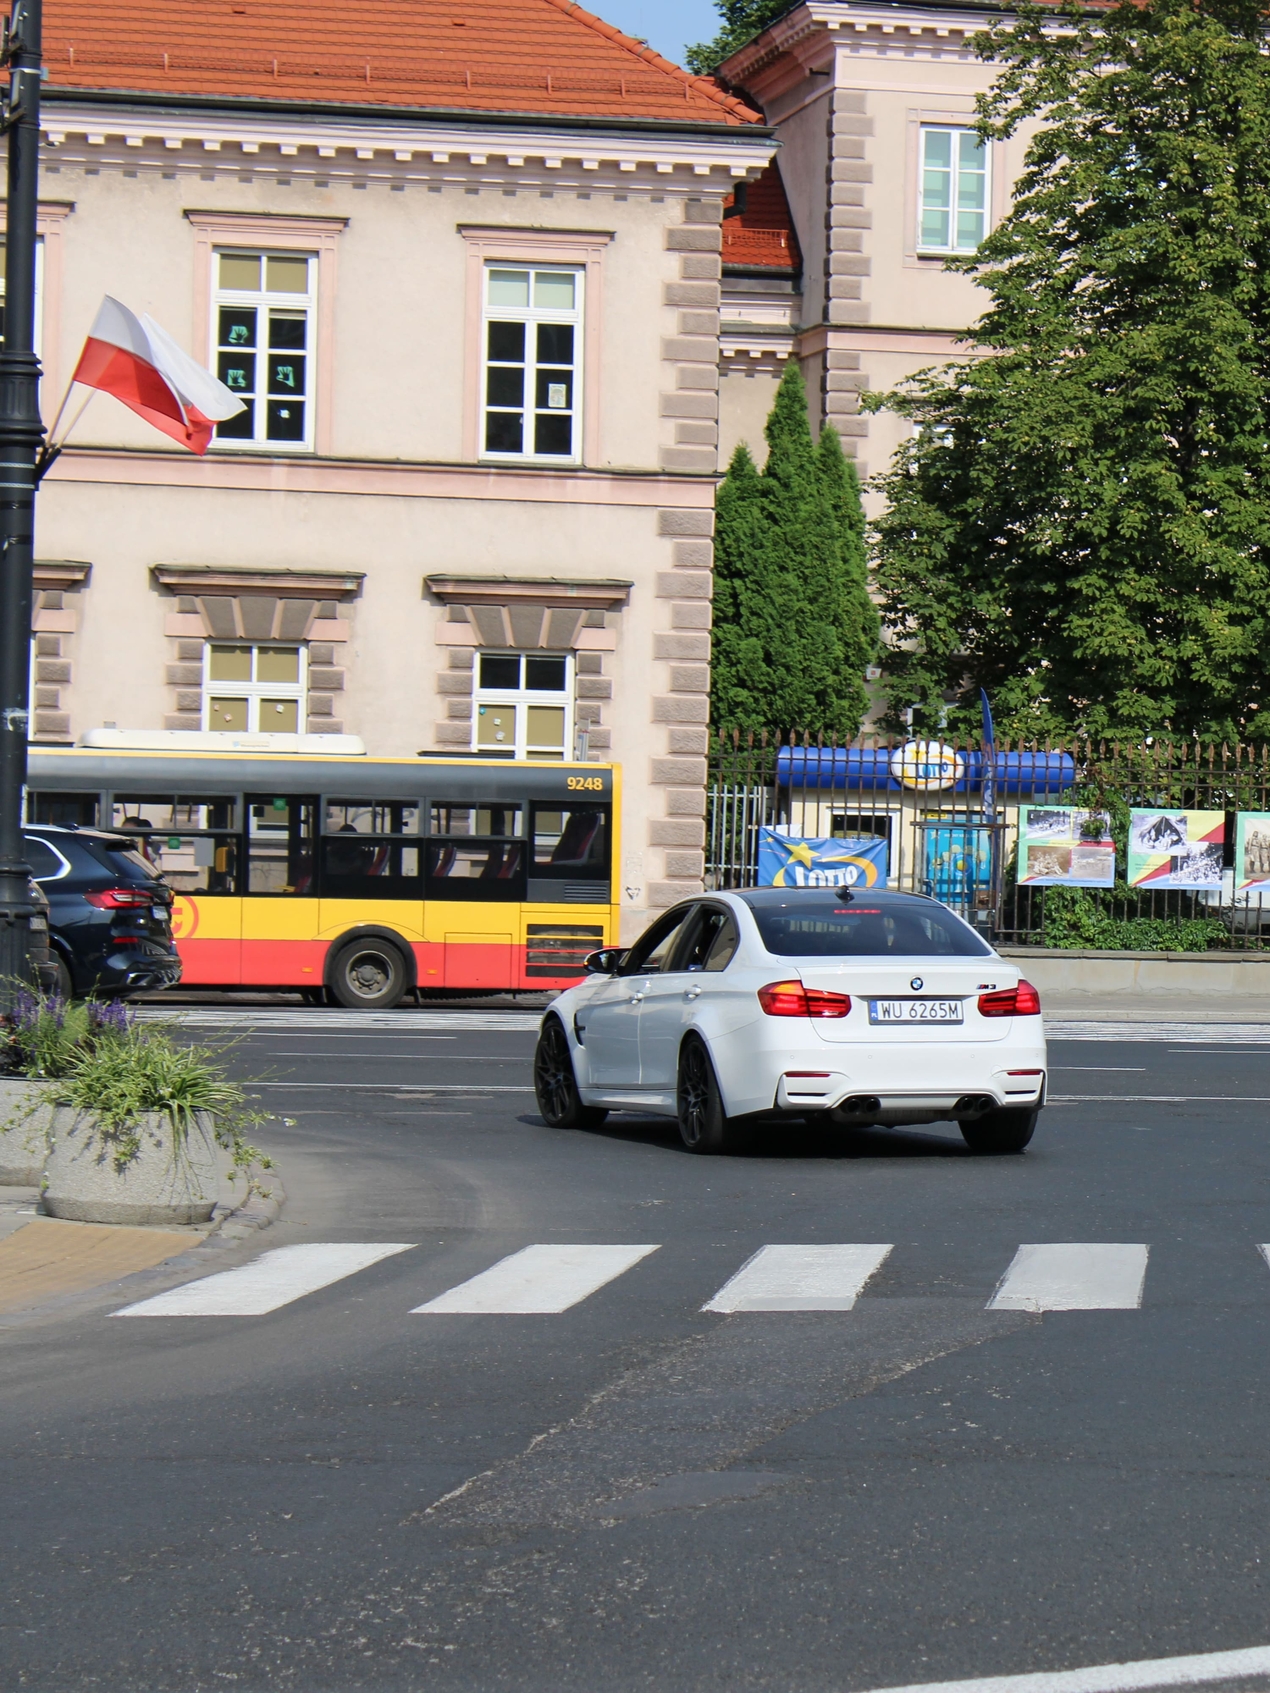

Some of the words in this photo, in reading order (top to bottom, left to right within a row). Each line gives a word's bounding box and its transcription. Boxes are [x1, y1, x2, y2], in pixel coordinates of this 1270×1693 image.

[567, 776, 603, 791] 9248
[795, 865, 858, 887] LOTTO
[881, 1003, 902, 1019] WU
[908, 1002, 959, 1019] 6265M
